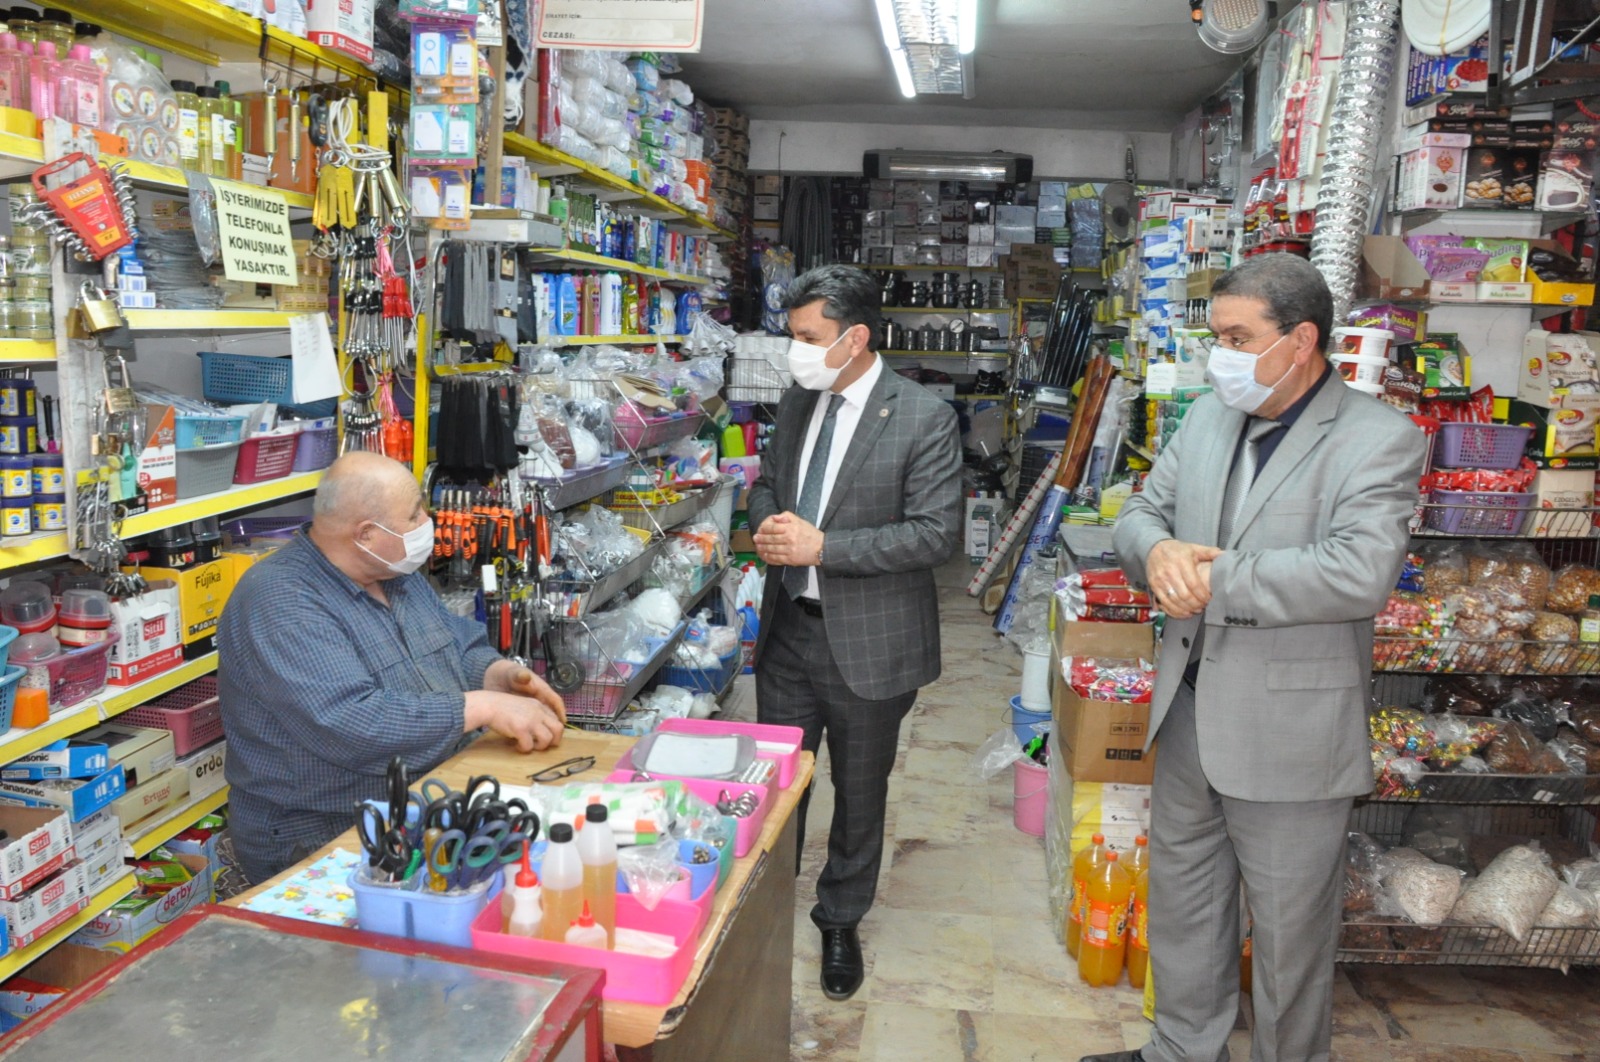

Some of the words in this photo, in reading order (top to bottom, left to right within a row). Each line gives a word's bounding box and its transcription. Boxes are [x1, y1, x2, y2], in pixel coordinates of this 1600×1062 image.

[542, 31, 576, 40] CEZASI:
[219, 185, 285, 215] İŞYERİMİZDE
[225, 212, 284, 236] TELEFONLA
[228, 234, 289, 257] KONUŞMAK
[233, 258, 291, 277] YASAKTIR.
[195, 571, 222, 590] Fujika
[143, 618, 165, 637] Sitil
[17, 753, 50, 764] asonic
[195, 755, 223, 778] erda
[0, 782, 46, 798] Panasonic
[30, 834, 49, 853] Sitil
[43, 882, 64, 903] Sitil
[163, 883, 193, 912] derby
